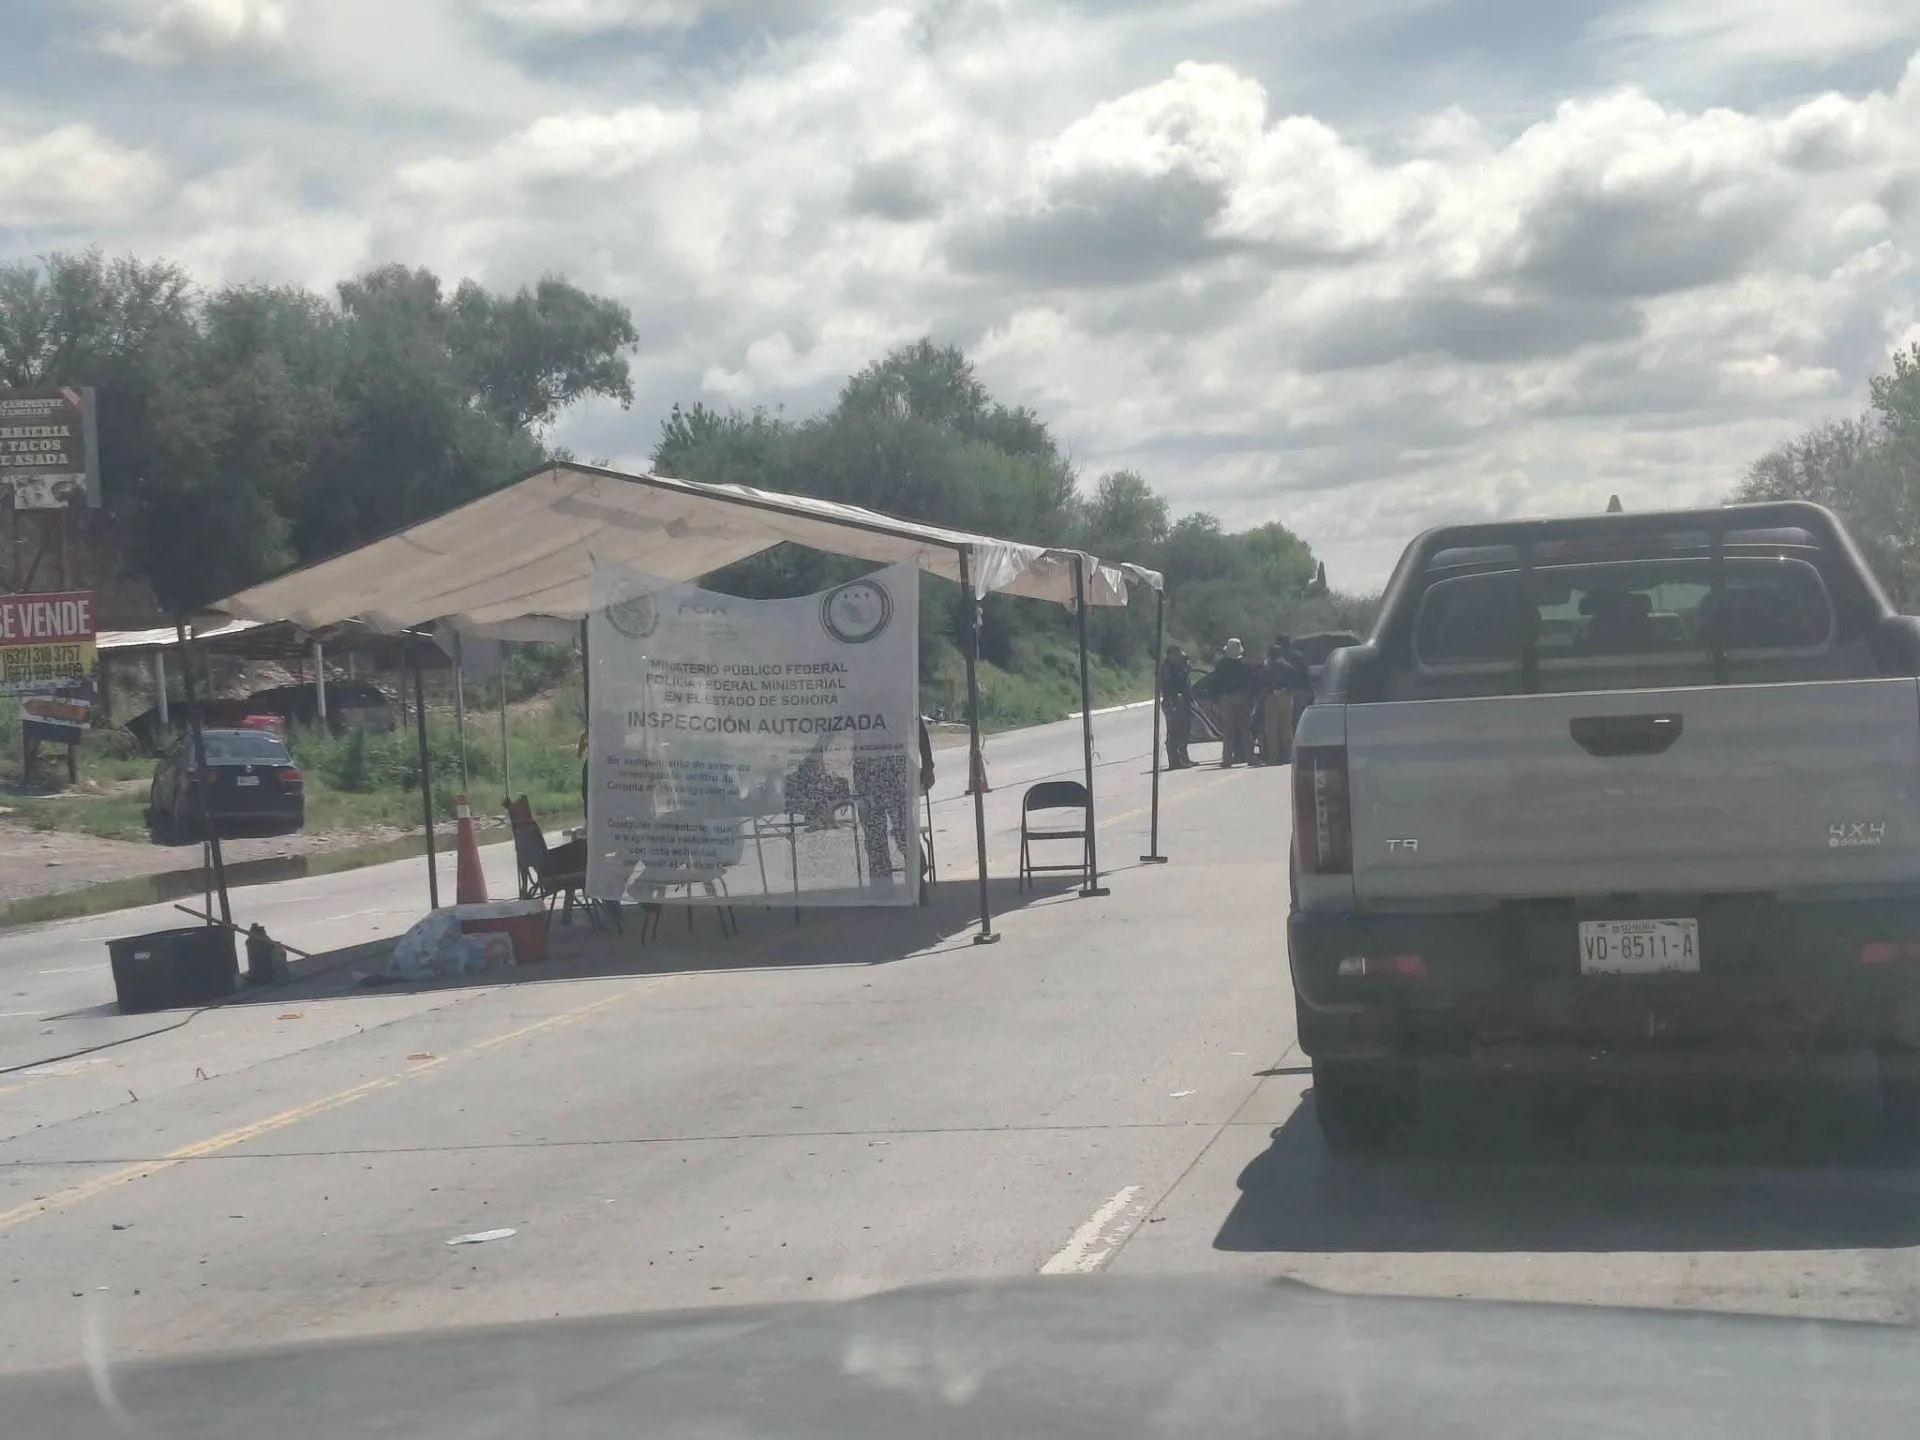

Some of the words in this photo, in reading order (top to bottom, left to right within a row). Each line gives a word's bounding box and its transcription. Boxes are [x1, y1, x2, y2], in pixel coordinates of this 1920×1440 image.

[7, 439, 61, 452] TACOS
[0, 455, 11, 466] E
[14, 453, 69, 466] ASADA
[18, 600, 91, 638] VENDE
[53, 644, 80, 663] 3757
[786, 662, 848, 675] FEDERAL
[698, 680, 757, 692] EDERAL
[761, 678, 846, 691] MINISTERIAL
[666, 691, 682, 703] EN
[760, 696, 777, 706] DE
[782, 695, 838, 706] SONORA
[628, 710, 751, 734] INSPECCIÓN
[757, 713, 886, 734] AUTORIZADA
[1584, 934, 1693, 960] VD-8511-A
